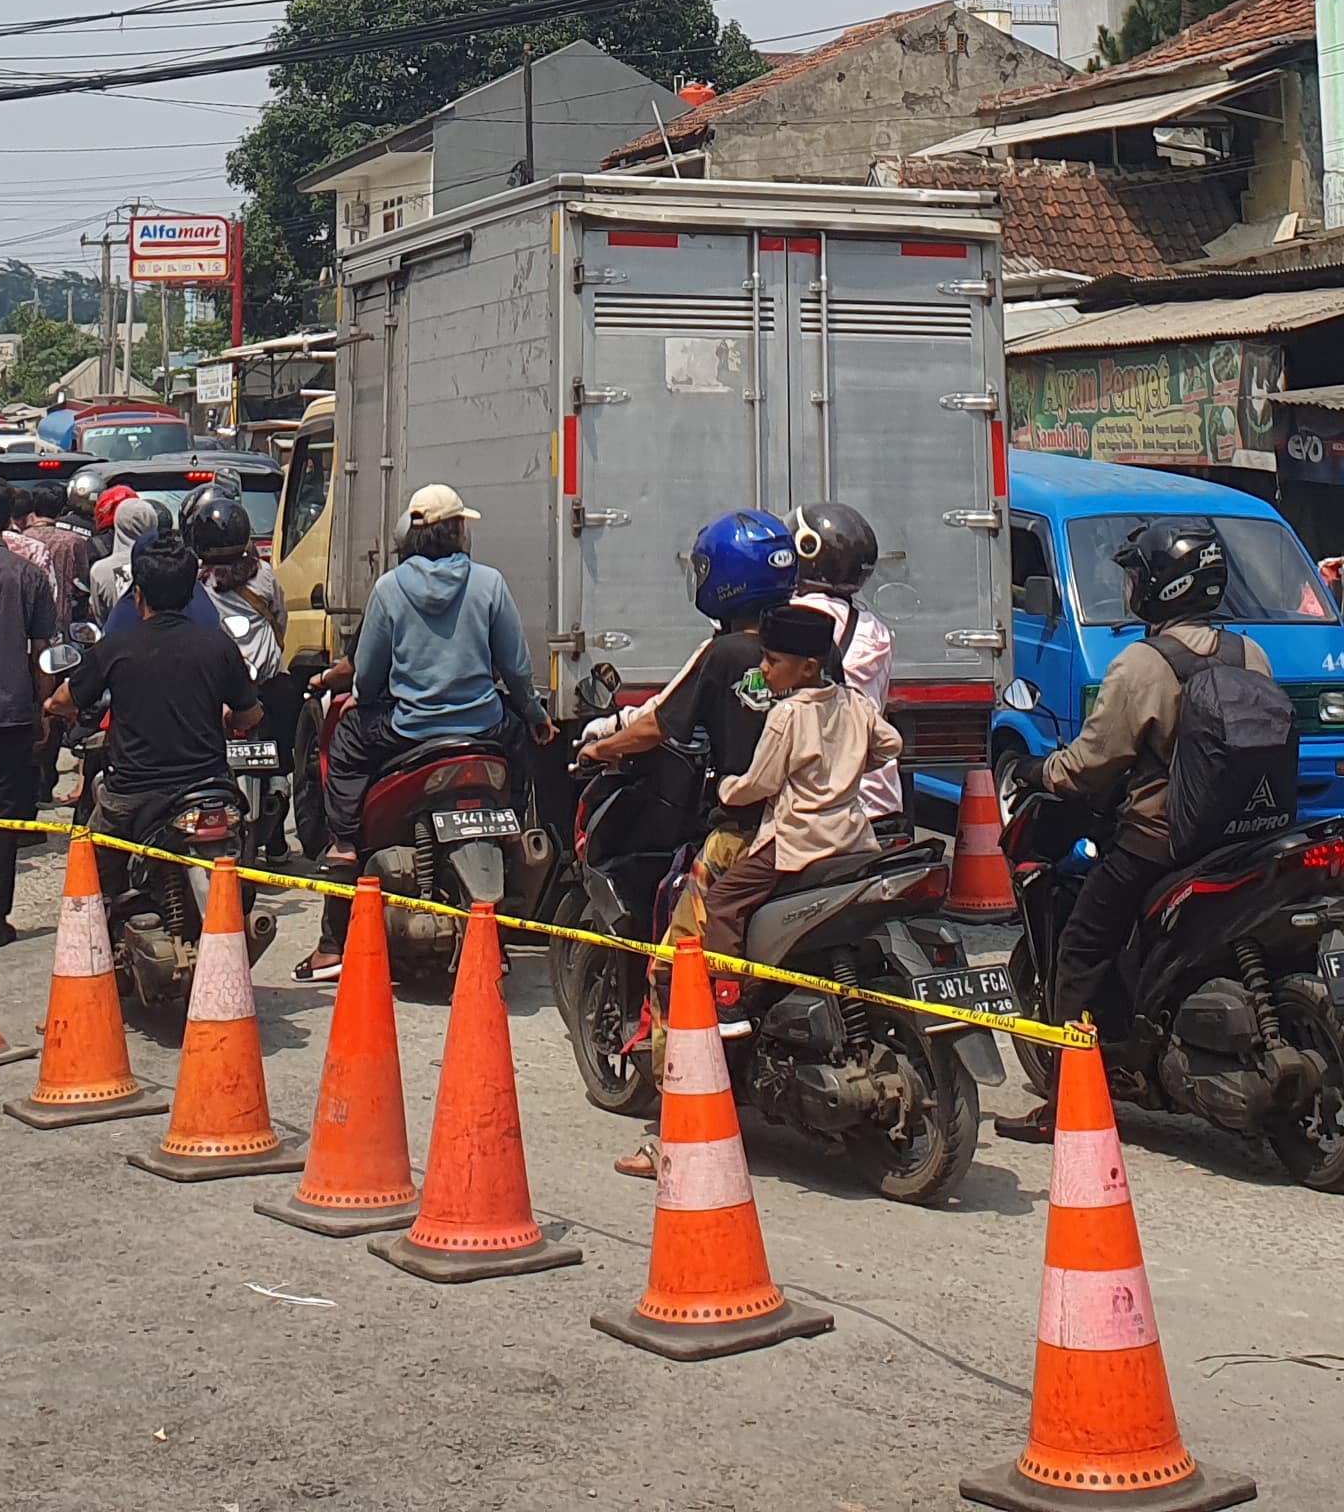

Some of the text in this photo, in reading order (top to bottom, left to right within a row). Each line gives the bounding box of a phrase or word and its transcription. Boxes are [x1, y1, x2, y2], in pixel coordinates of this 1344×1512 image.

[139, 224, 223, 239] Alfamart
[1044, 356, 1170, 424] Ayam Penyet
[1287, 434, 1323, 462] evo
[1164, 579, 1187, 598] INK
[436, 816, 444, 827] B
[1224, 814, 1289, 834] AIMPRO
[1329, 958, 1340, 976] F
[918, 983, 928, 1001] F
[937, 976, 974, 999] 3874
